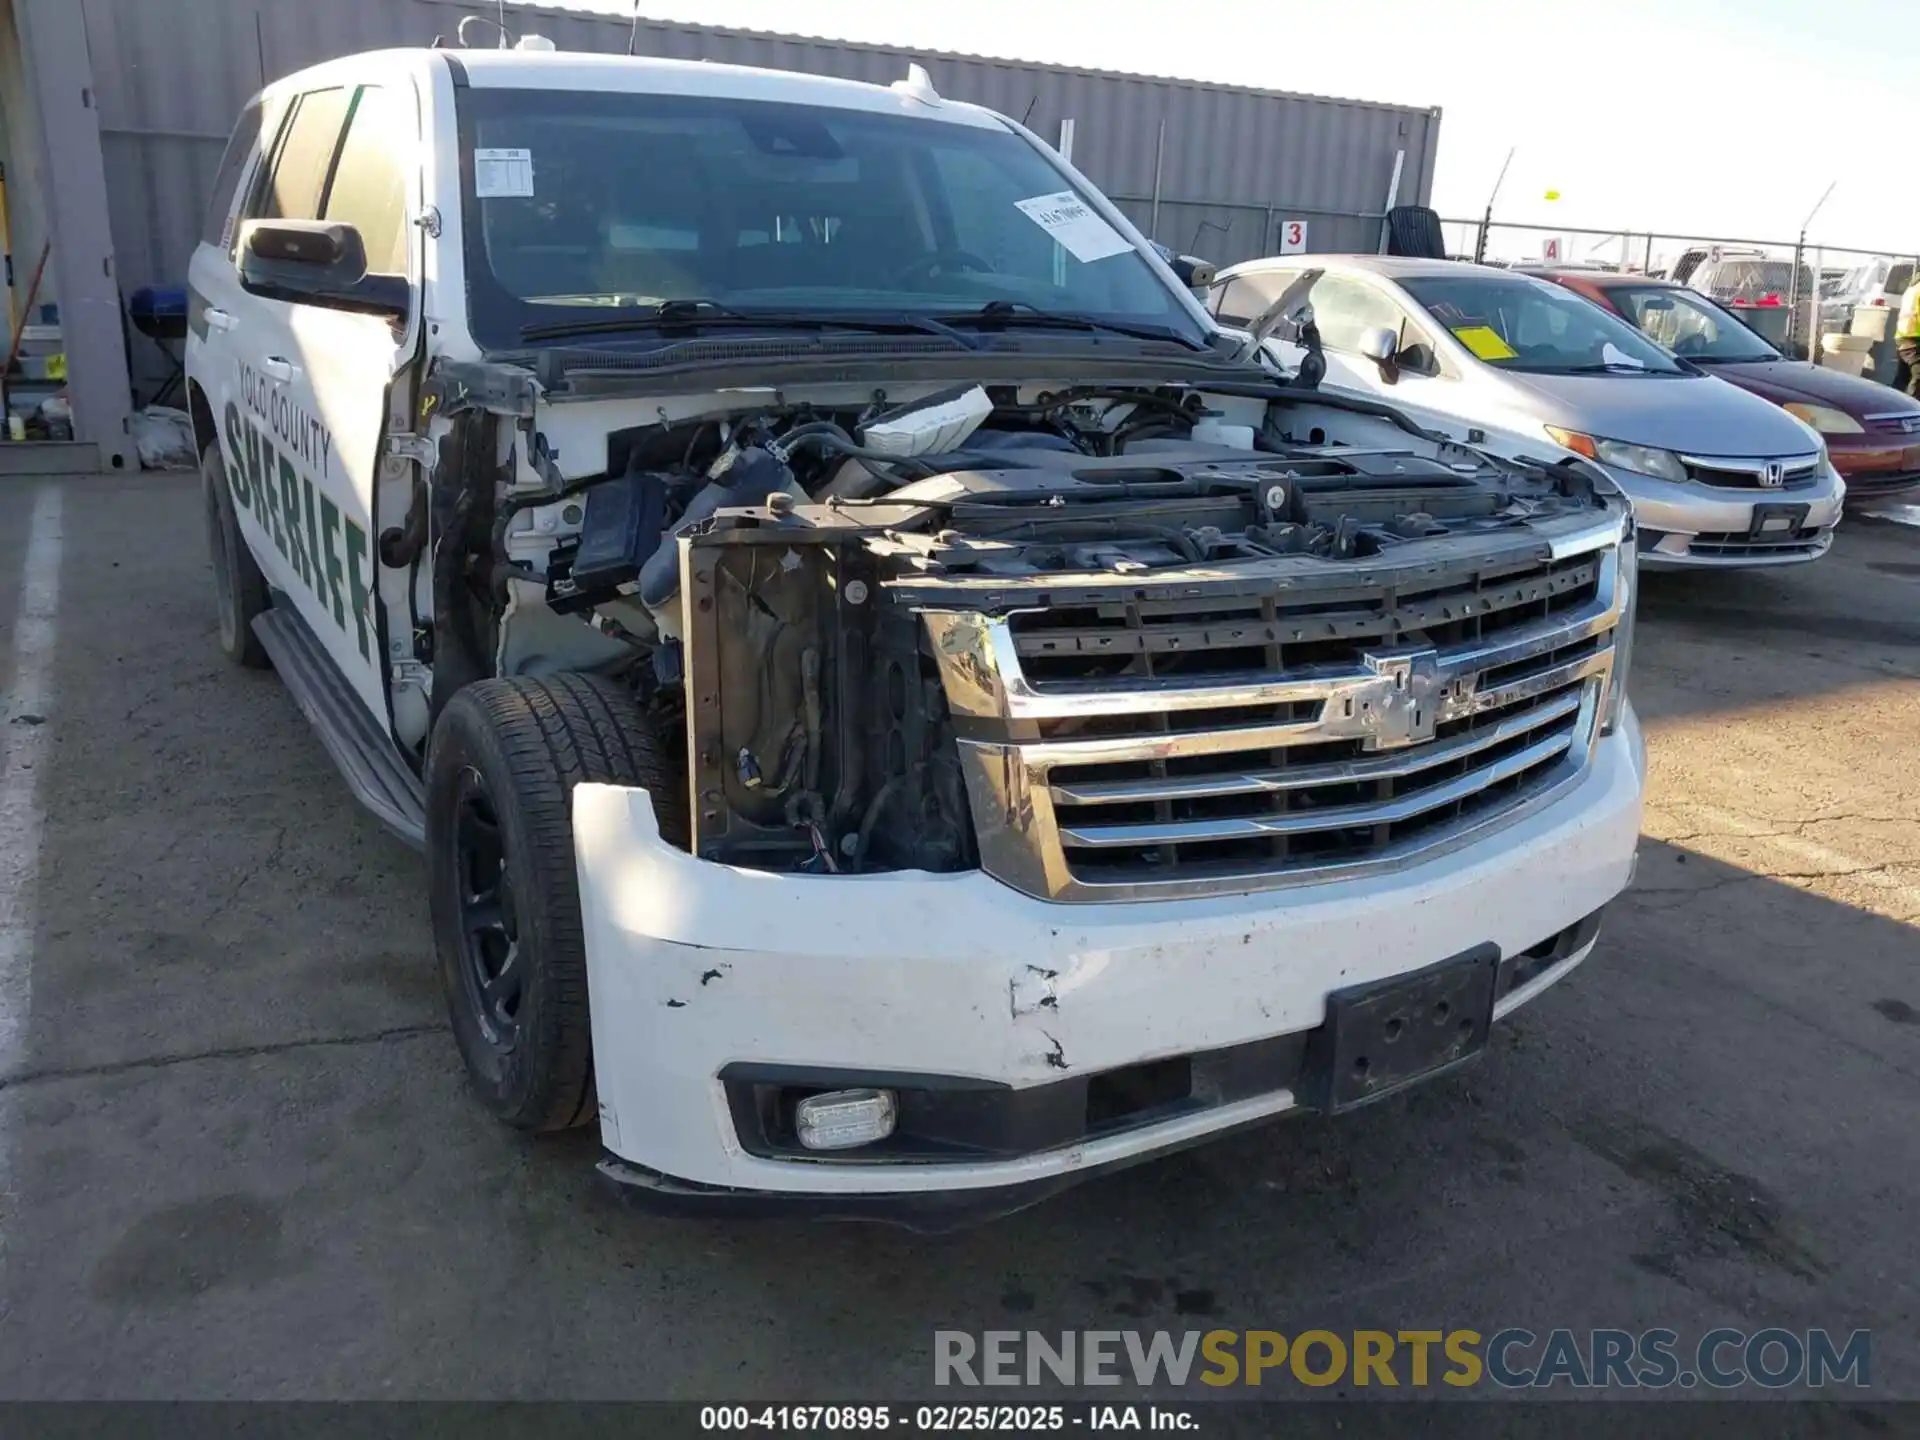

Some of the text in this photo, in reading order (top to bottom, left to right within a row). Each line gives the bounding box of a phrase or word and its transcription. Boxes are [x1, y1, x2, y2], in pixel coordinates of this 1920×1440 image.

[1287, 223, 1301, 245] 3
[1546, 240, 1557, 259] 4
[1711, 245, 1721, 264] 5
[238, 357, 333, 480] YOLO COUNTY
[223, 401, 371, 668] SHERIFF
